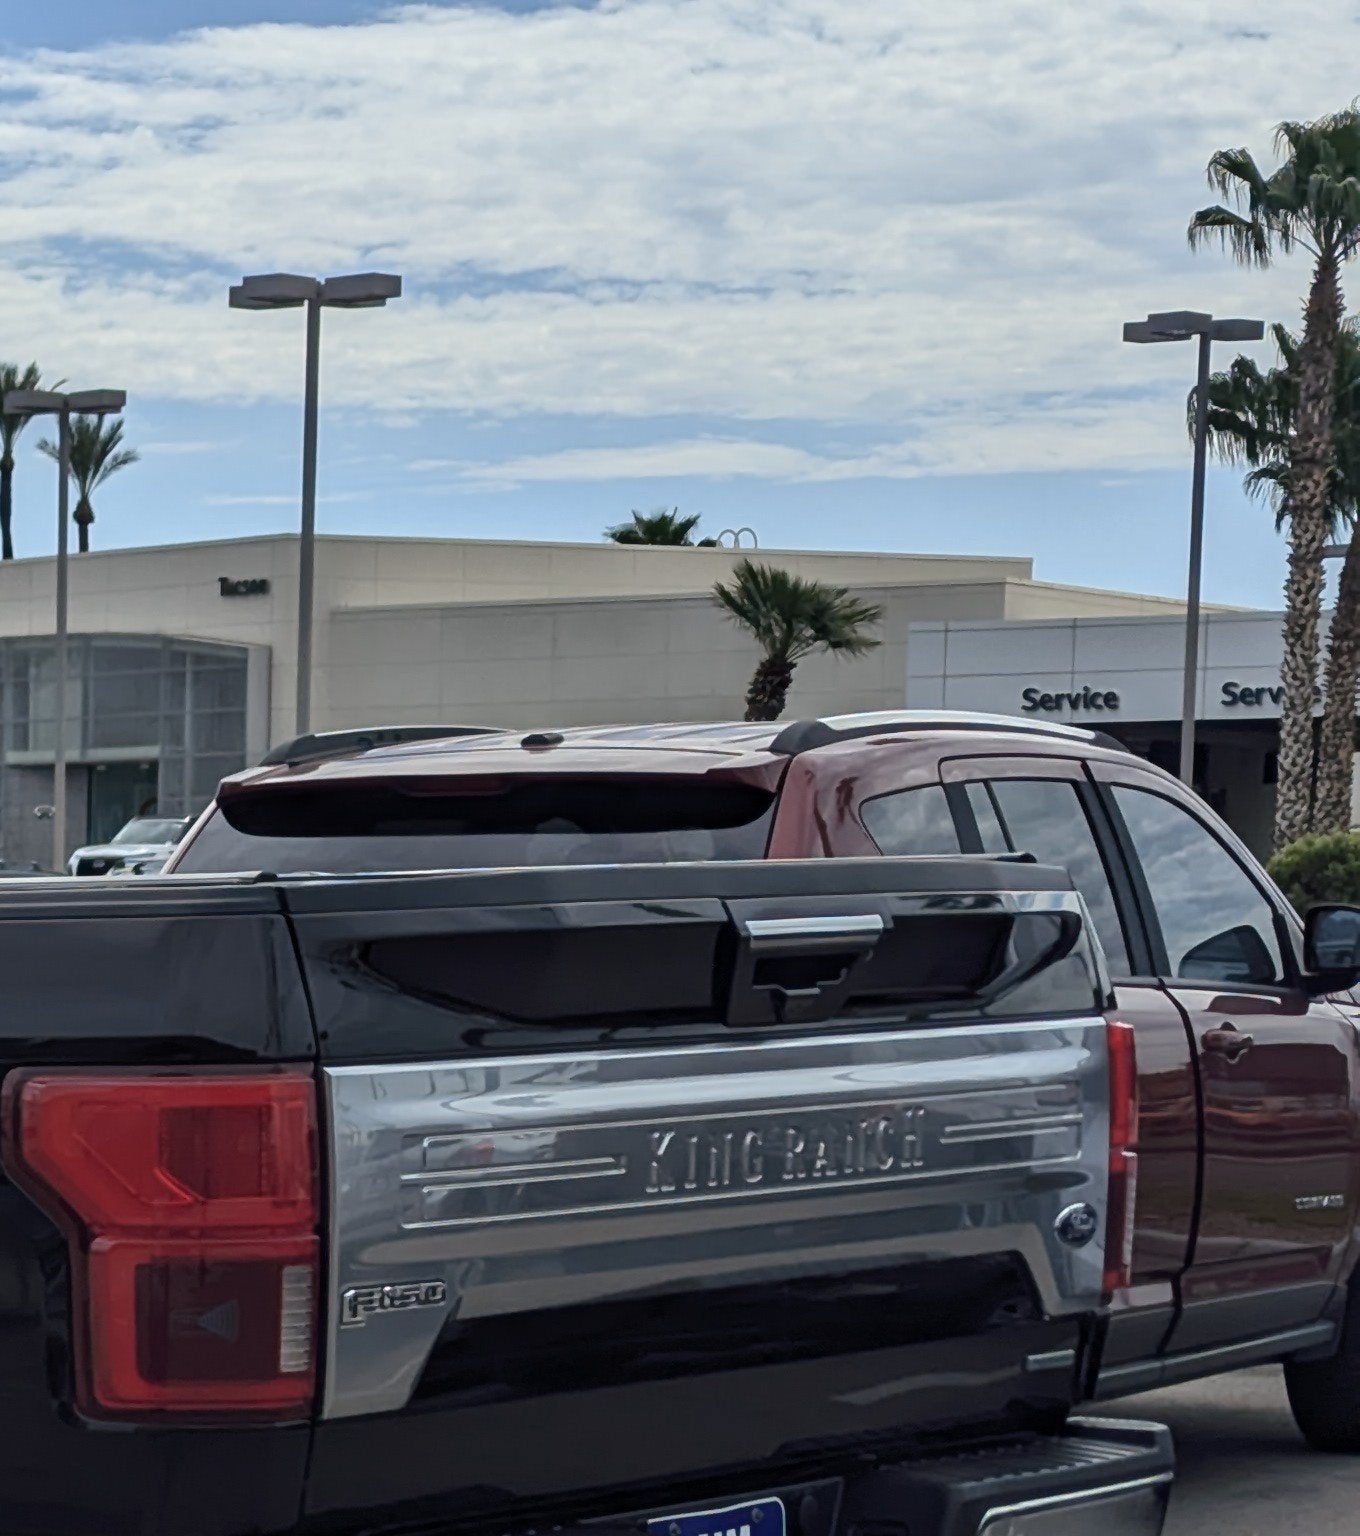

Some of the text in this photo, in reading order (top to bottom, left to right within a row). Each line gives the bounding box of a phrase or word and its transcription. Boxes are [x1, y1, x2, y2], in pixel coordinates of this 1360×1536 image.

[1021, 686, 1120, 712] Service
[1220, 681, 1322, 706] Serve
[645, 1106, 924, 1193] KING RANCH
